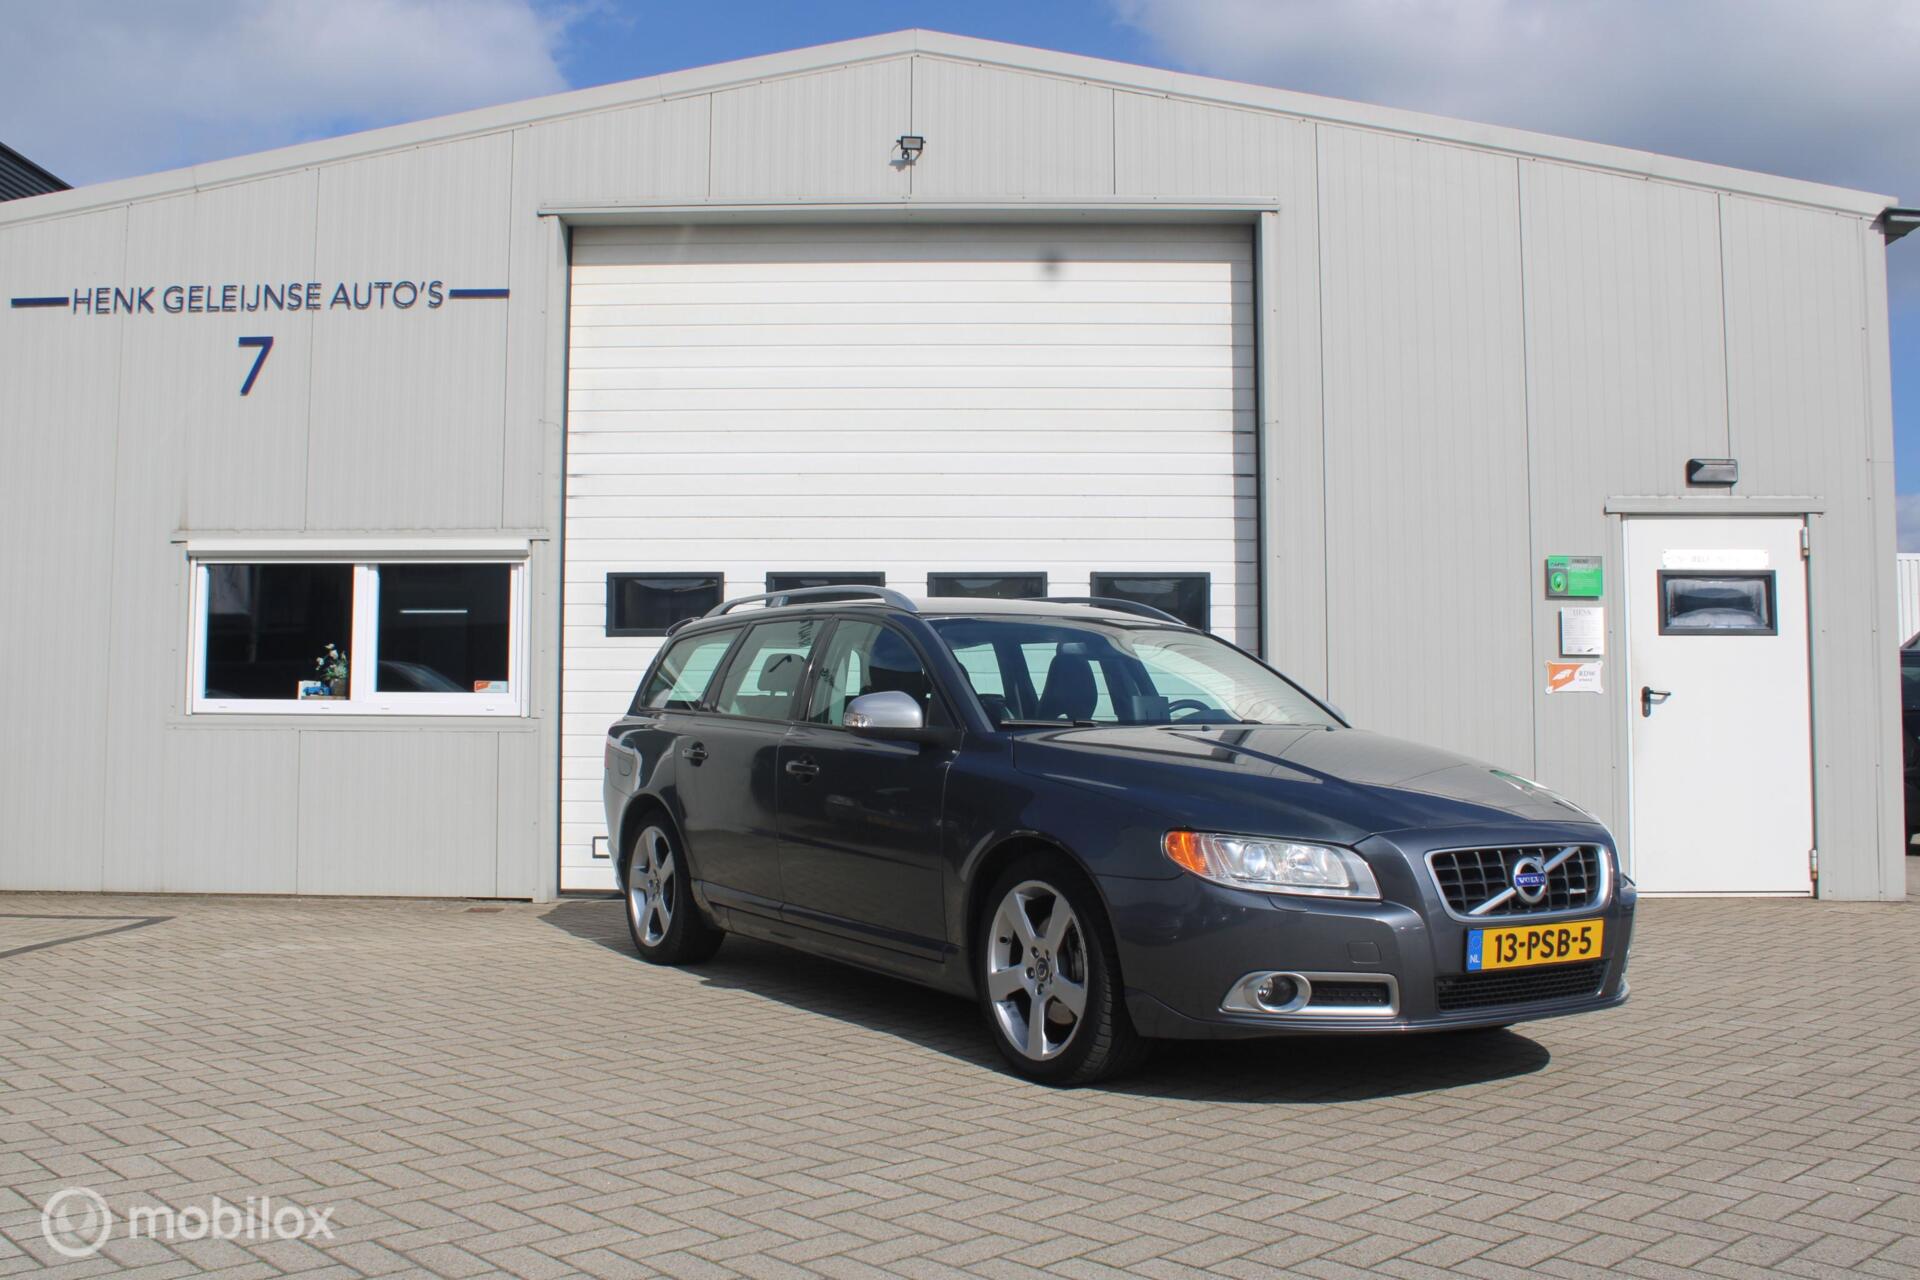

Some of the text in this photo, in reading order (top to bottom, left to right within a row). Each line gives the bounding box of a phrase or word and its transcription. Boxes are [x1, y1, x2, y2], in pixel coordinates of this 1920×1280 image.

[73, 280, 444, 315] HENK GELEIJNSE AUTO'S
[238, 335, 275, 397] 7
[1518, 876, 1545, 884] VOLVO
[1469, 954, 1481, 964] NL
[1495, 926, 1592, 964] 13-PSB-5
